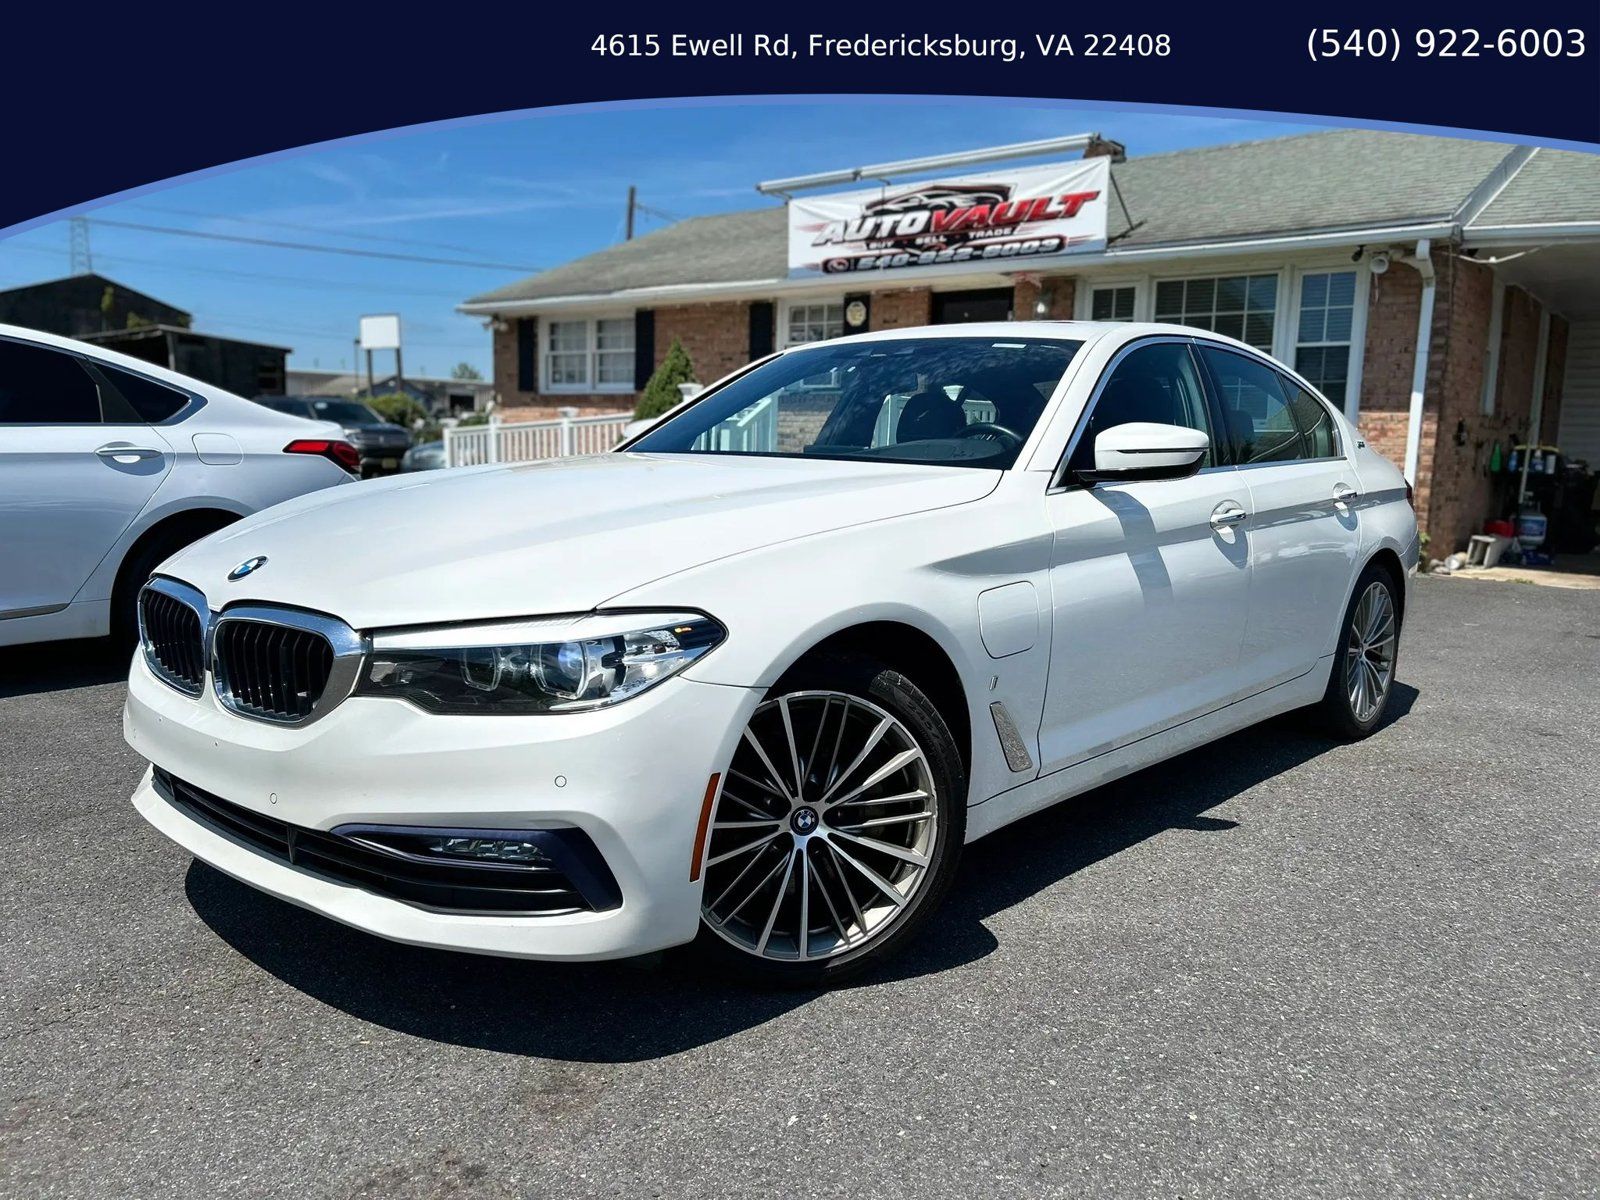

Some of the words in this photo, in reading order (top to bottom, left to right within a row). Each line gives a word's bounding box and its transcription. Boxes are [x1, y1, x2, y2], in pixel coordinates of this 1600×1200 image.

[869, 240, 894, 249] BUY
[915, 235, 947, 245] SELL
[968, 228, 1012, 239] TRADE
